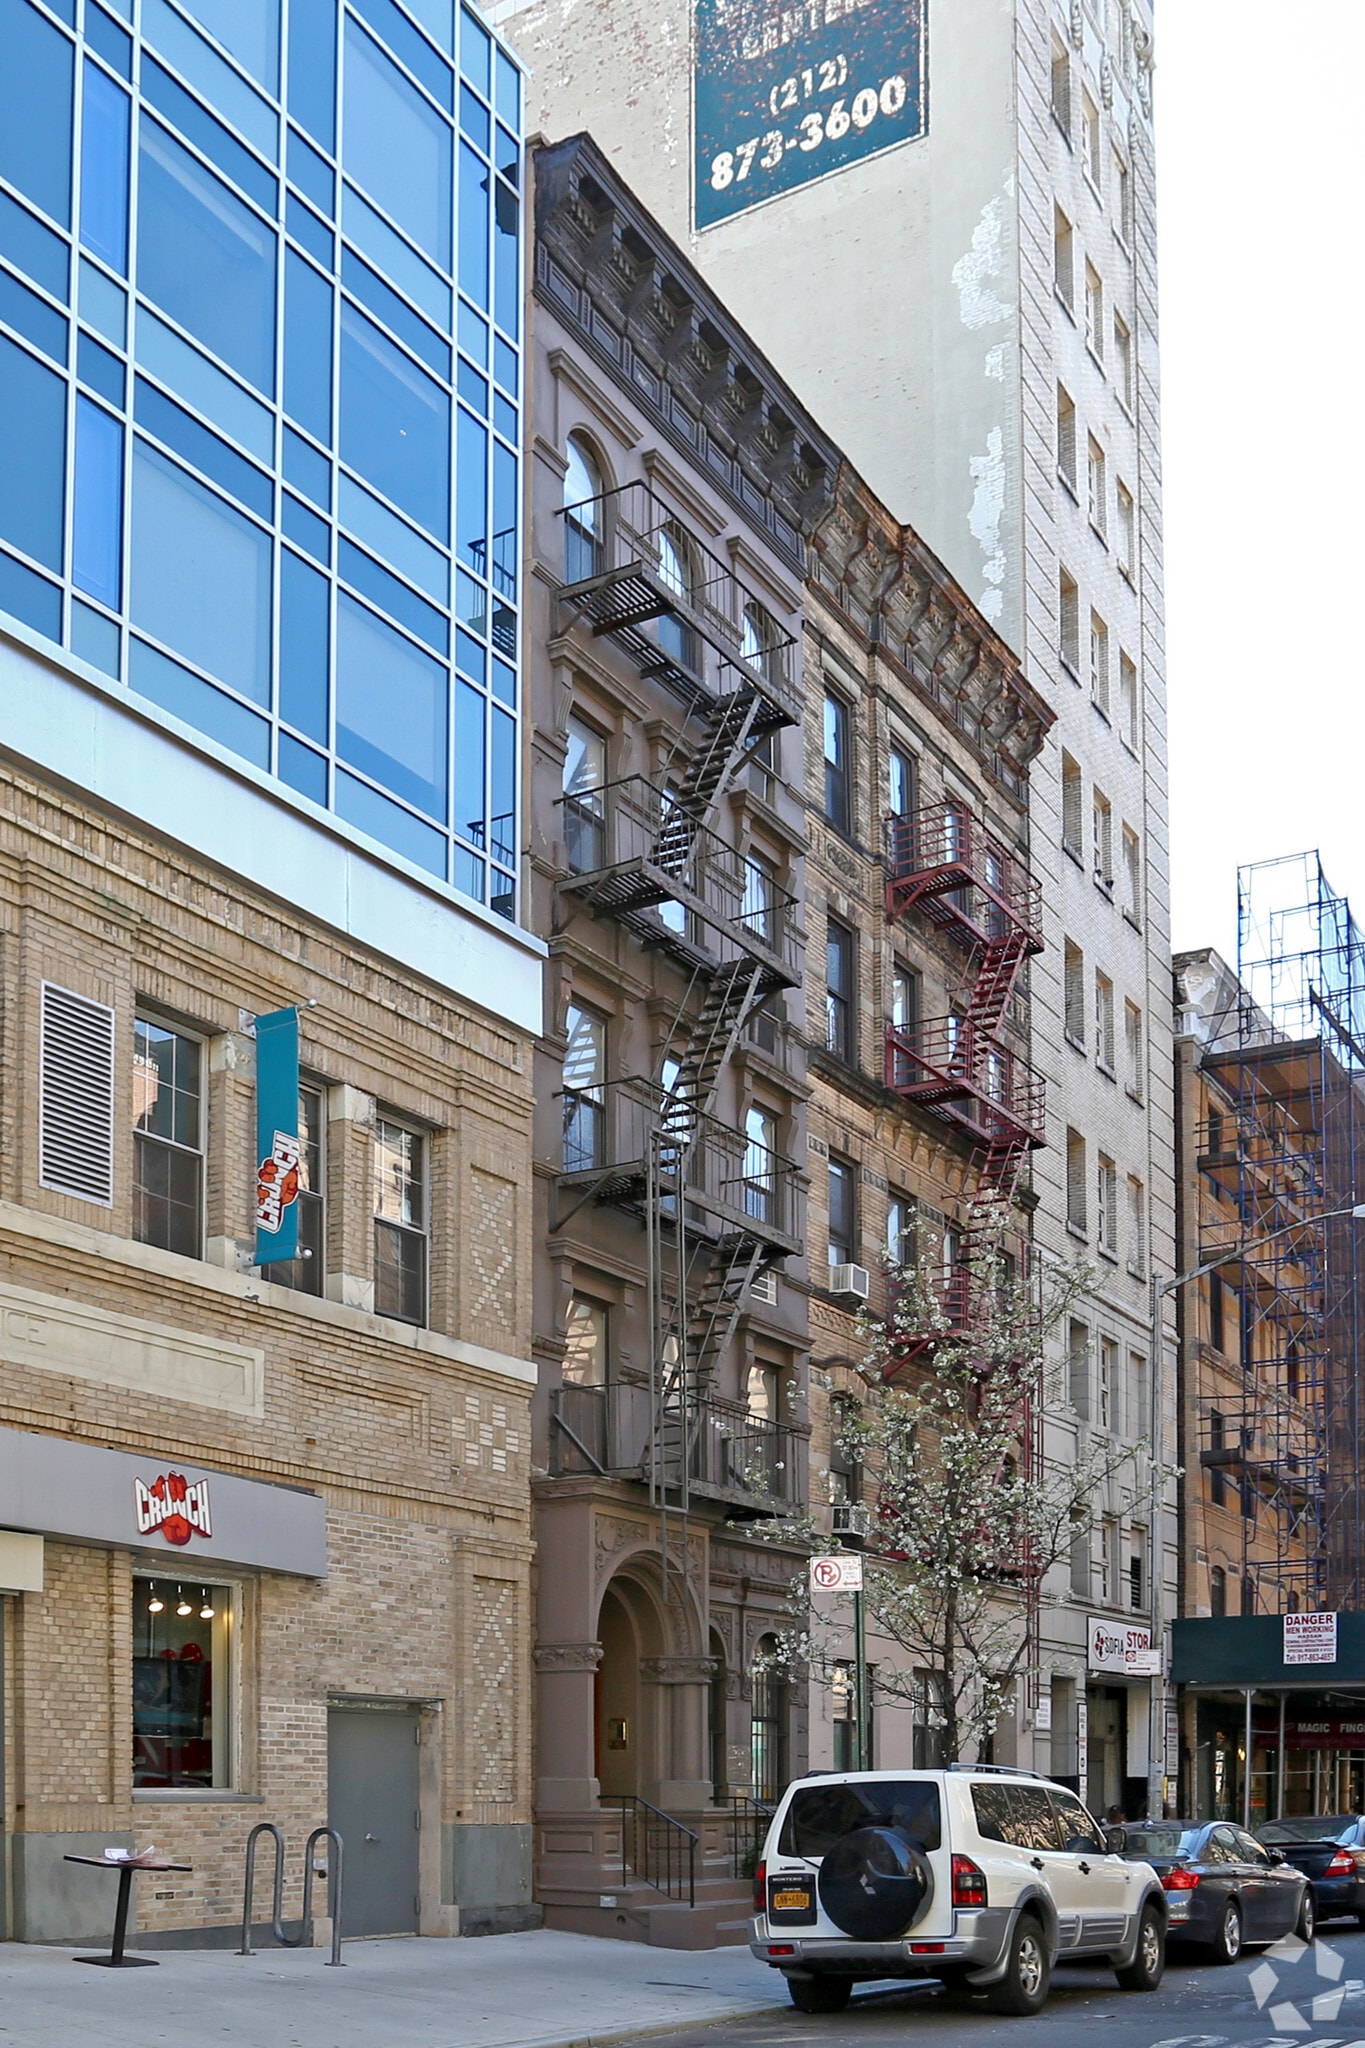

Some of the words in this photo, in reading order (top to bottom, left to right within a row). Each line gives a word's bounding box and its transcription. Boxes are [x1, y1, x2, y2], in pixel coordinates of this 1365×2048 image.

[769, 53, 847, 116] (212)
[710, 74, 907, 191] 873-3600
[257, 1130, 299, 1233] CRUNCH
[135, 1478, 212, 1535] CRUNCH
[1286, 1614, 1334, 1626] DANGER
[1286, 1626, 1300, 1634] MEN
[1302, 1625, 1334, 1633] WORKING
[1297, 1722, 1331, 1733] MAGIC
